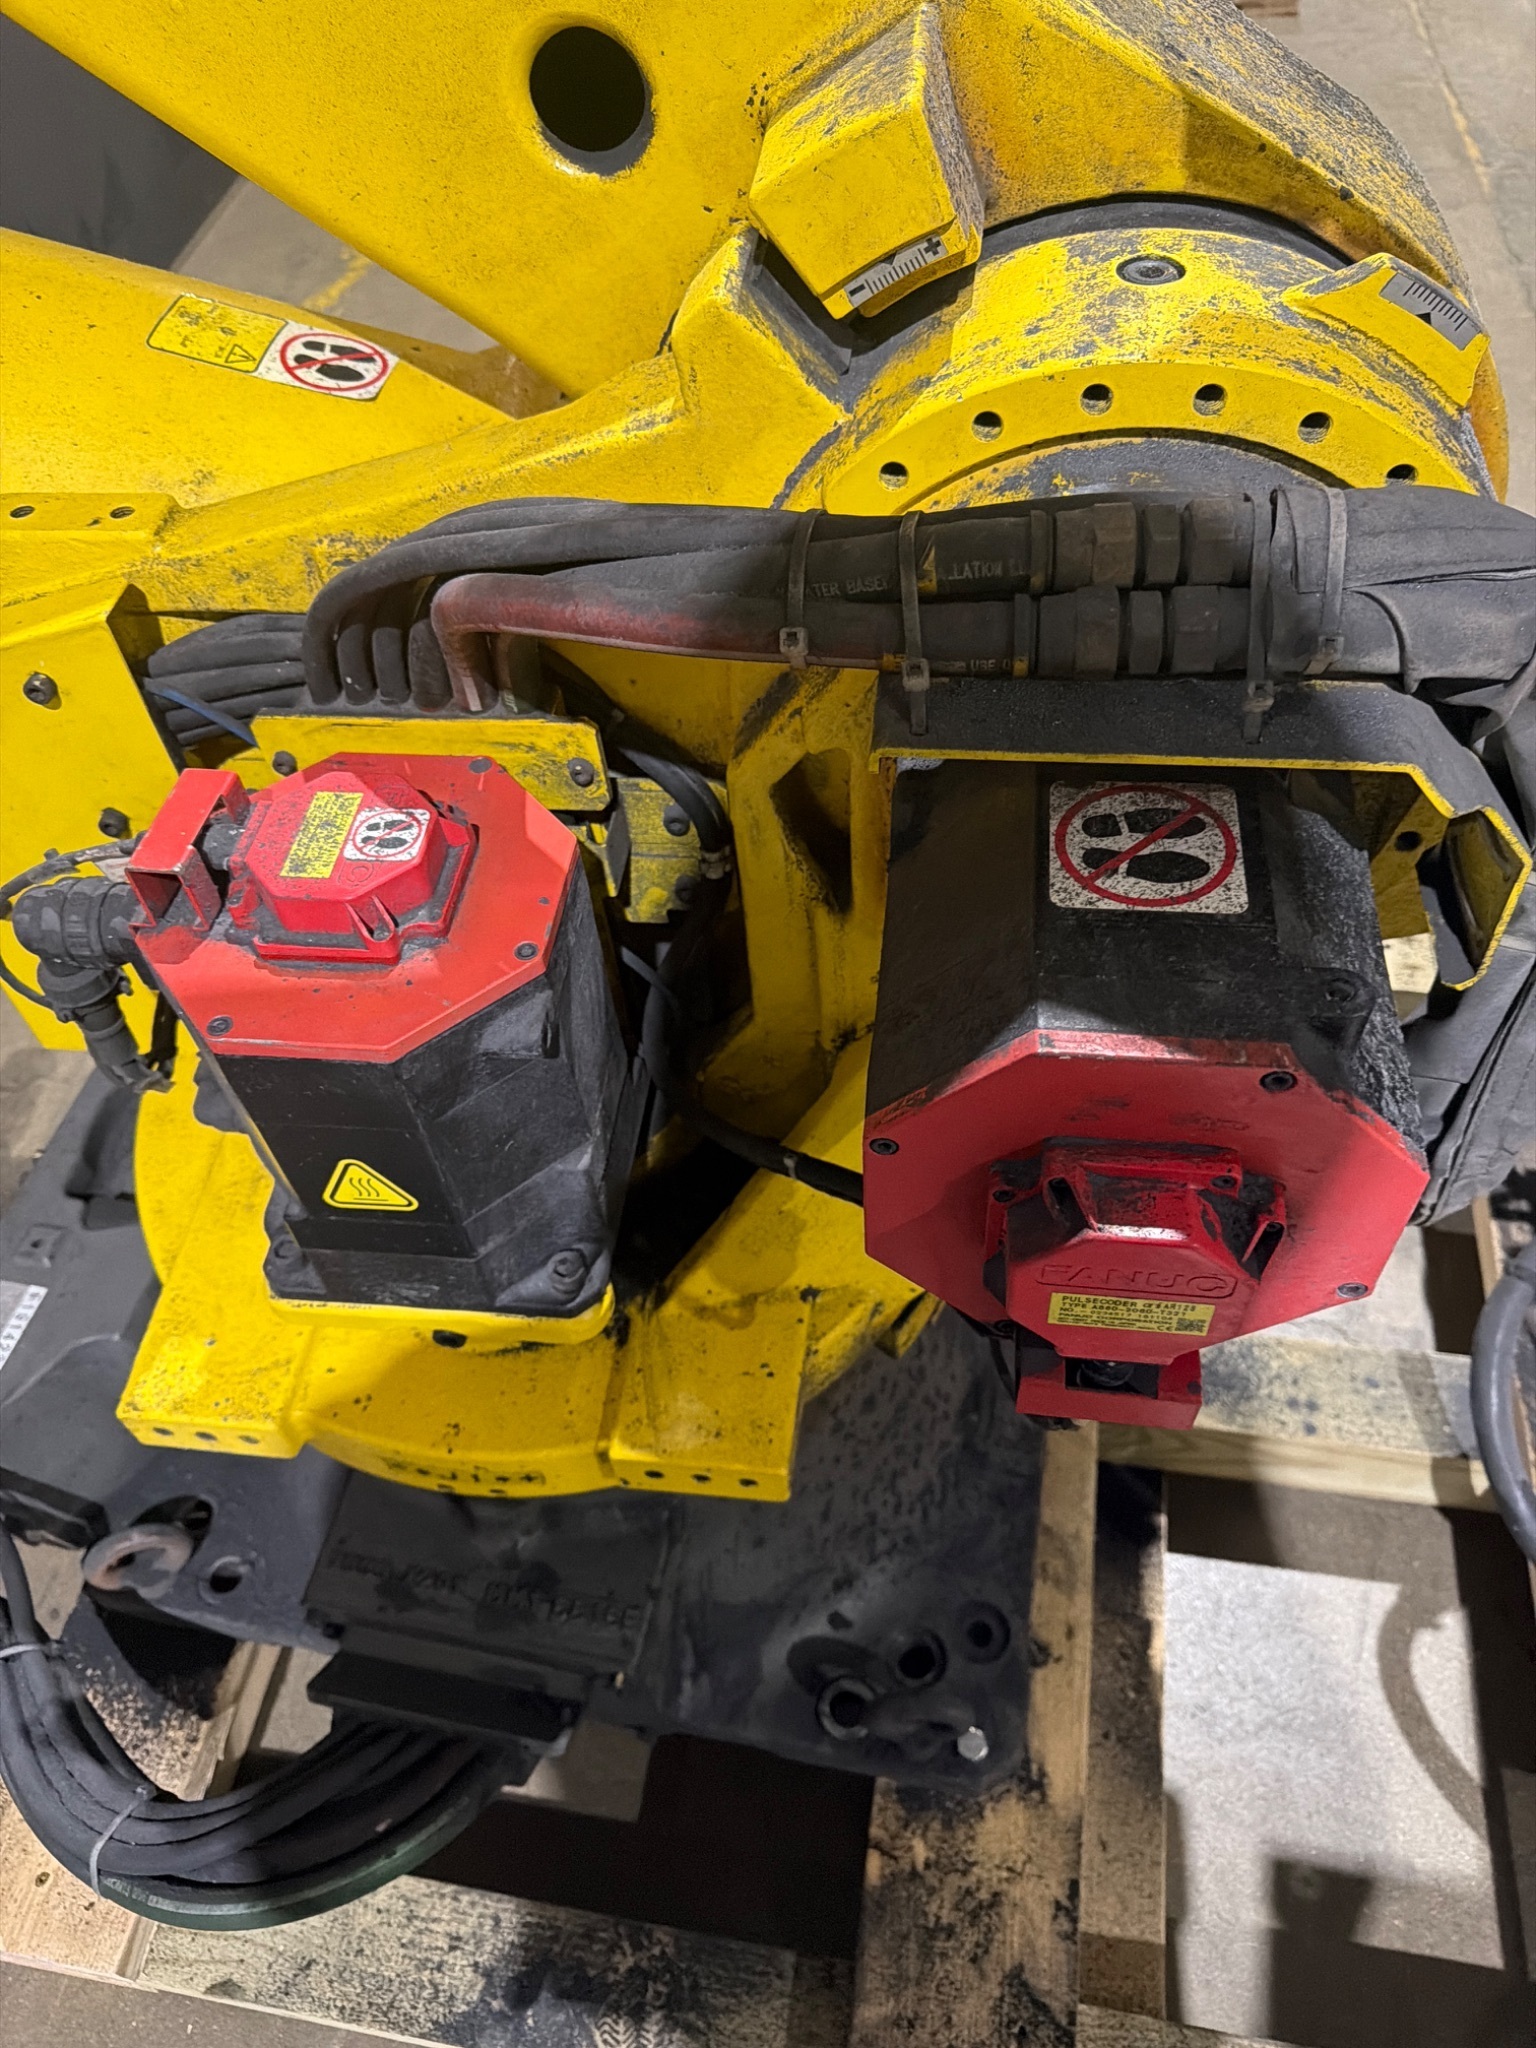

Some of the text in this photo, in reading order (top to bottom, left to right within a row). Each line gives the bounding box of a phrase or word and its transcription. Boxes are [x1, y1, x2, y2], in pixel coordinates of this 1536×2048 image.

[1041, 1265, 1227, 1292] FANUC
[1062, 1295, 1138, 1308] PULSECODER
[1062, 1301, 1087, 1309] TYPE
